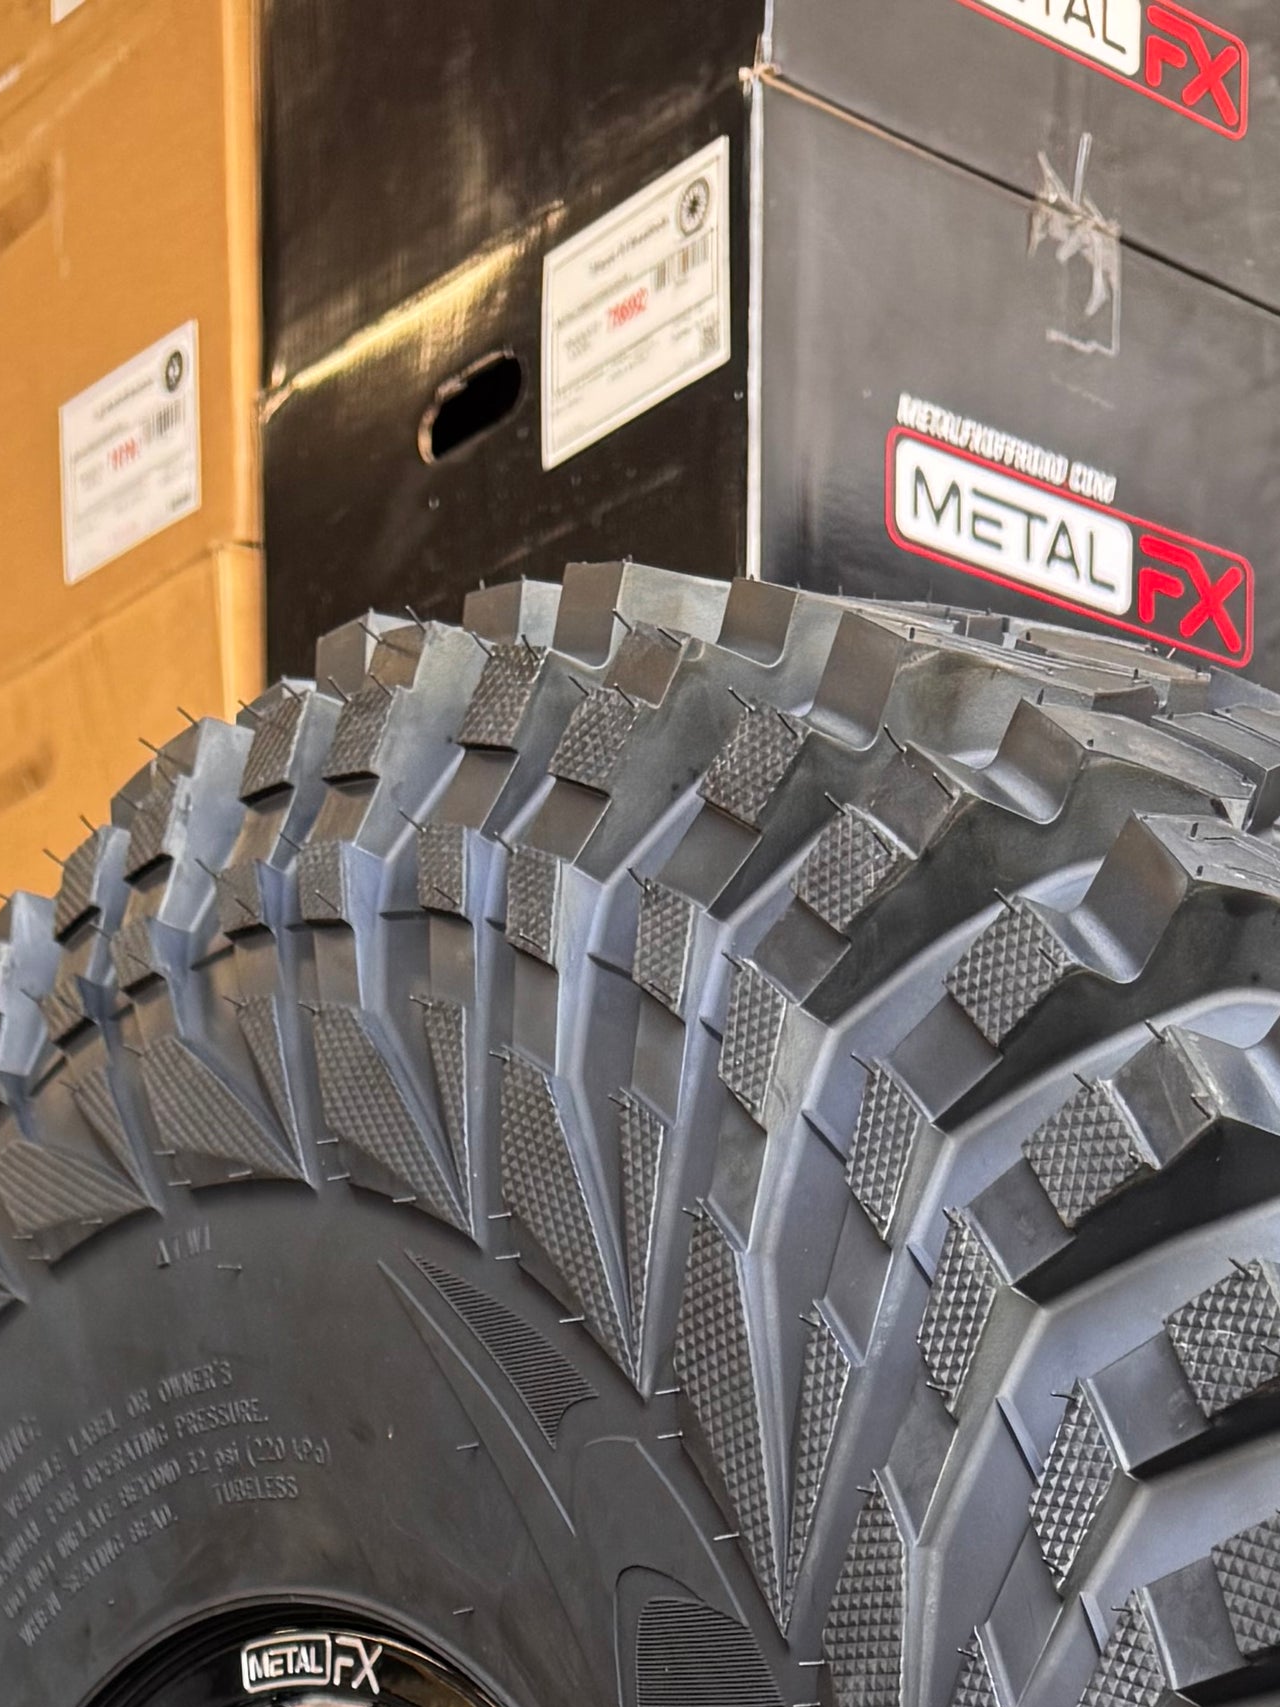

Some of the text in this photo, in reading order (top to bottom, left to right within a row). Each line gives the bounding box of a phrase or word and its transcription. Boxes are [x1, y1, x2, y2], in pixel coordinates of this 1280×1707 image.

[1146, 5, 1240, 127] FX
[913, 465, 1243, 654] METAL FX
[68, 1416, 121, 1458] LABEL
[126, 1389, 151, 1418] OR
[158, 1360, 233, 1405] OWNER'S
[210, 1475, 299, 1506] TUBELESS
[248, 1635, 384, 1694] METAL FX
